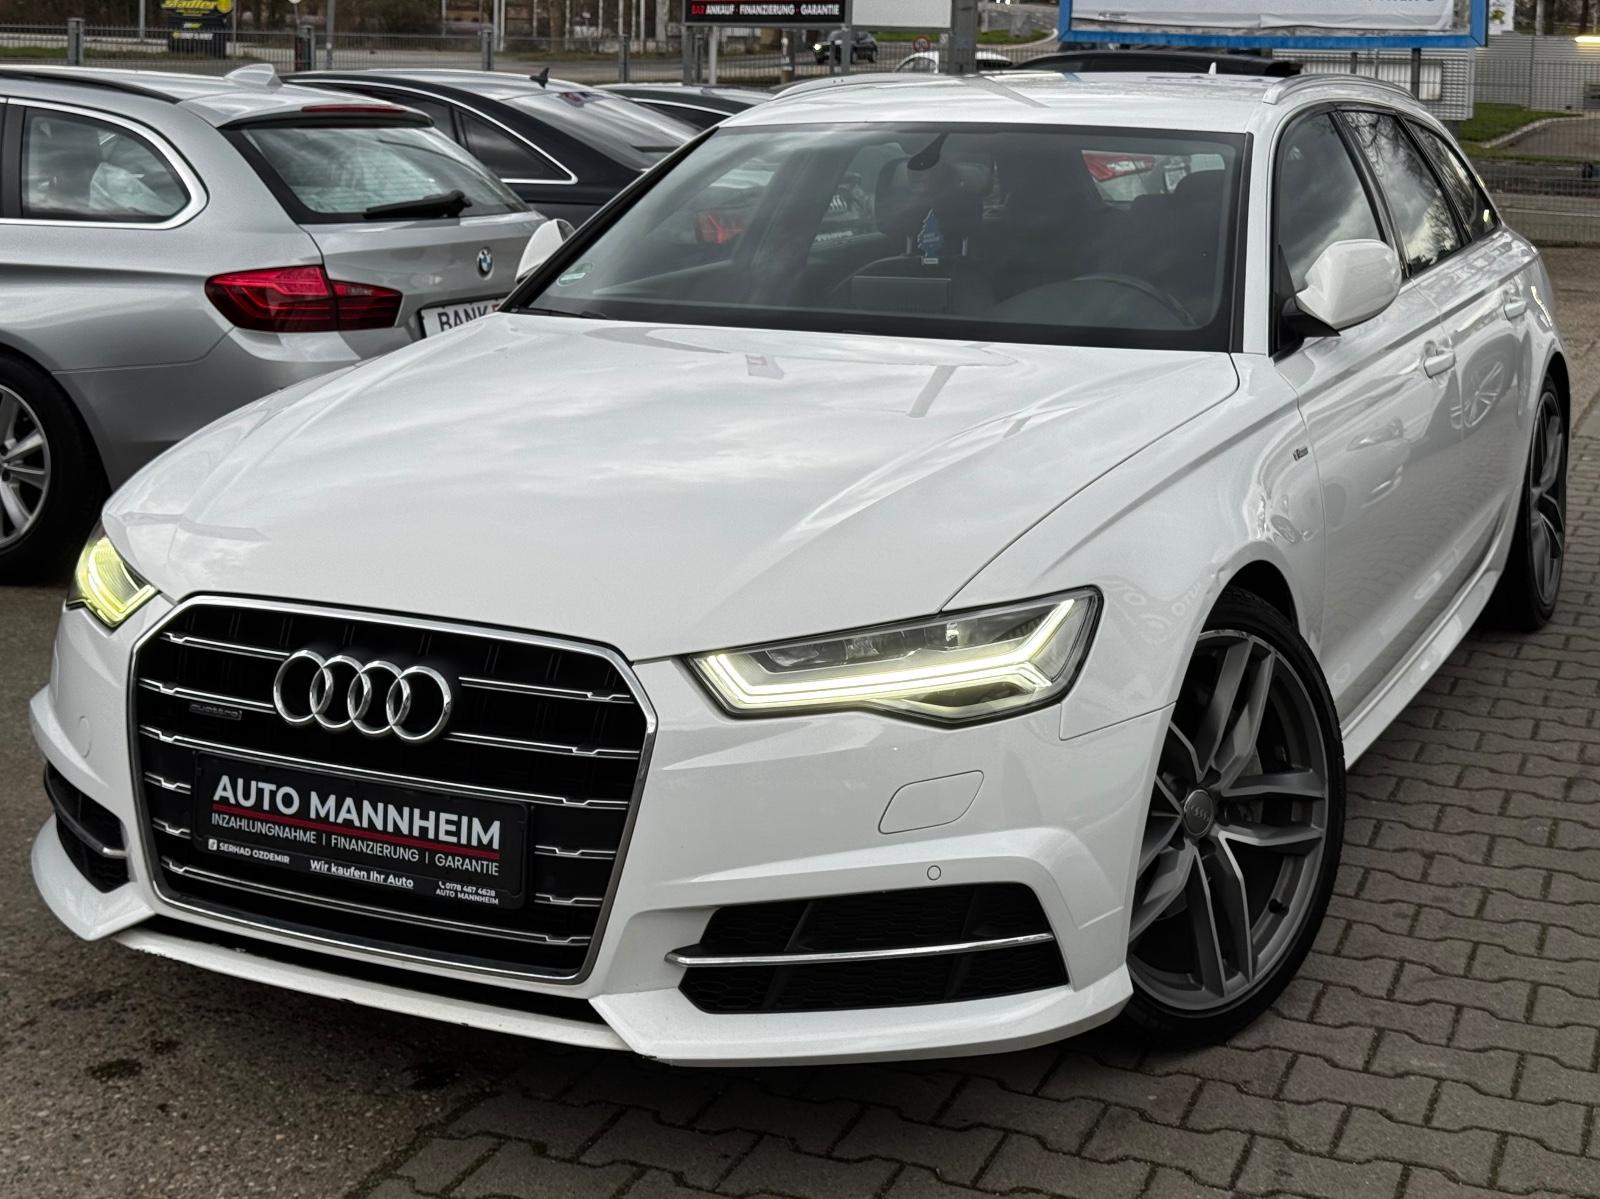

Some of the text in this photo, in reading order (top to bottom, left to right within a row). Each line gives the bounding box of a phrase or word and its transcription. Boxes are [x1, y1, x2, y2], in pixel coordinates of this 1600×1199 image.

[705, 4, 735, 15] ANKAUF
[739, 4, 795, 15] FINANZIERUNG
[800, 4, 840, 15] GARANTIE
[213, 774, 501, 850] AUTO MANNHEIM
[211, 812, 500, 876] INZAHLUNGNAHME FINANZIERUNG GARANTIE
[219, 842, 252, 857] SERHAD
[310, 859, 414, 889] Wir kaufen Ihr Auto
[435, 888, 499, 904] AUTO MANNHEIM
